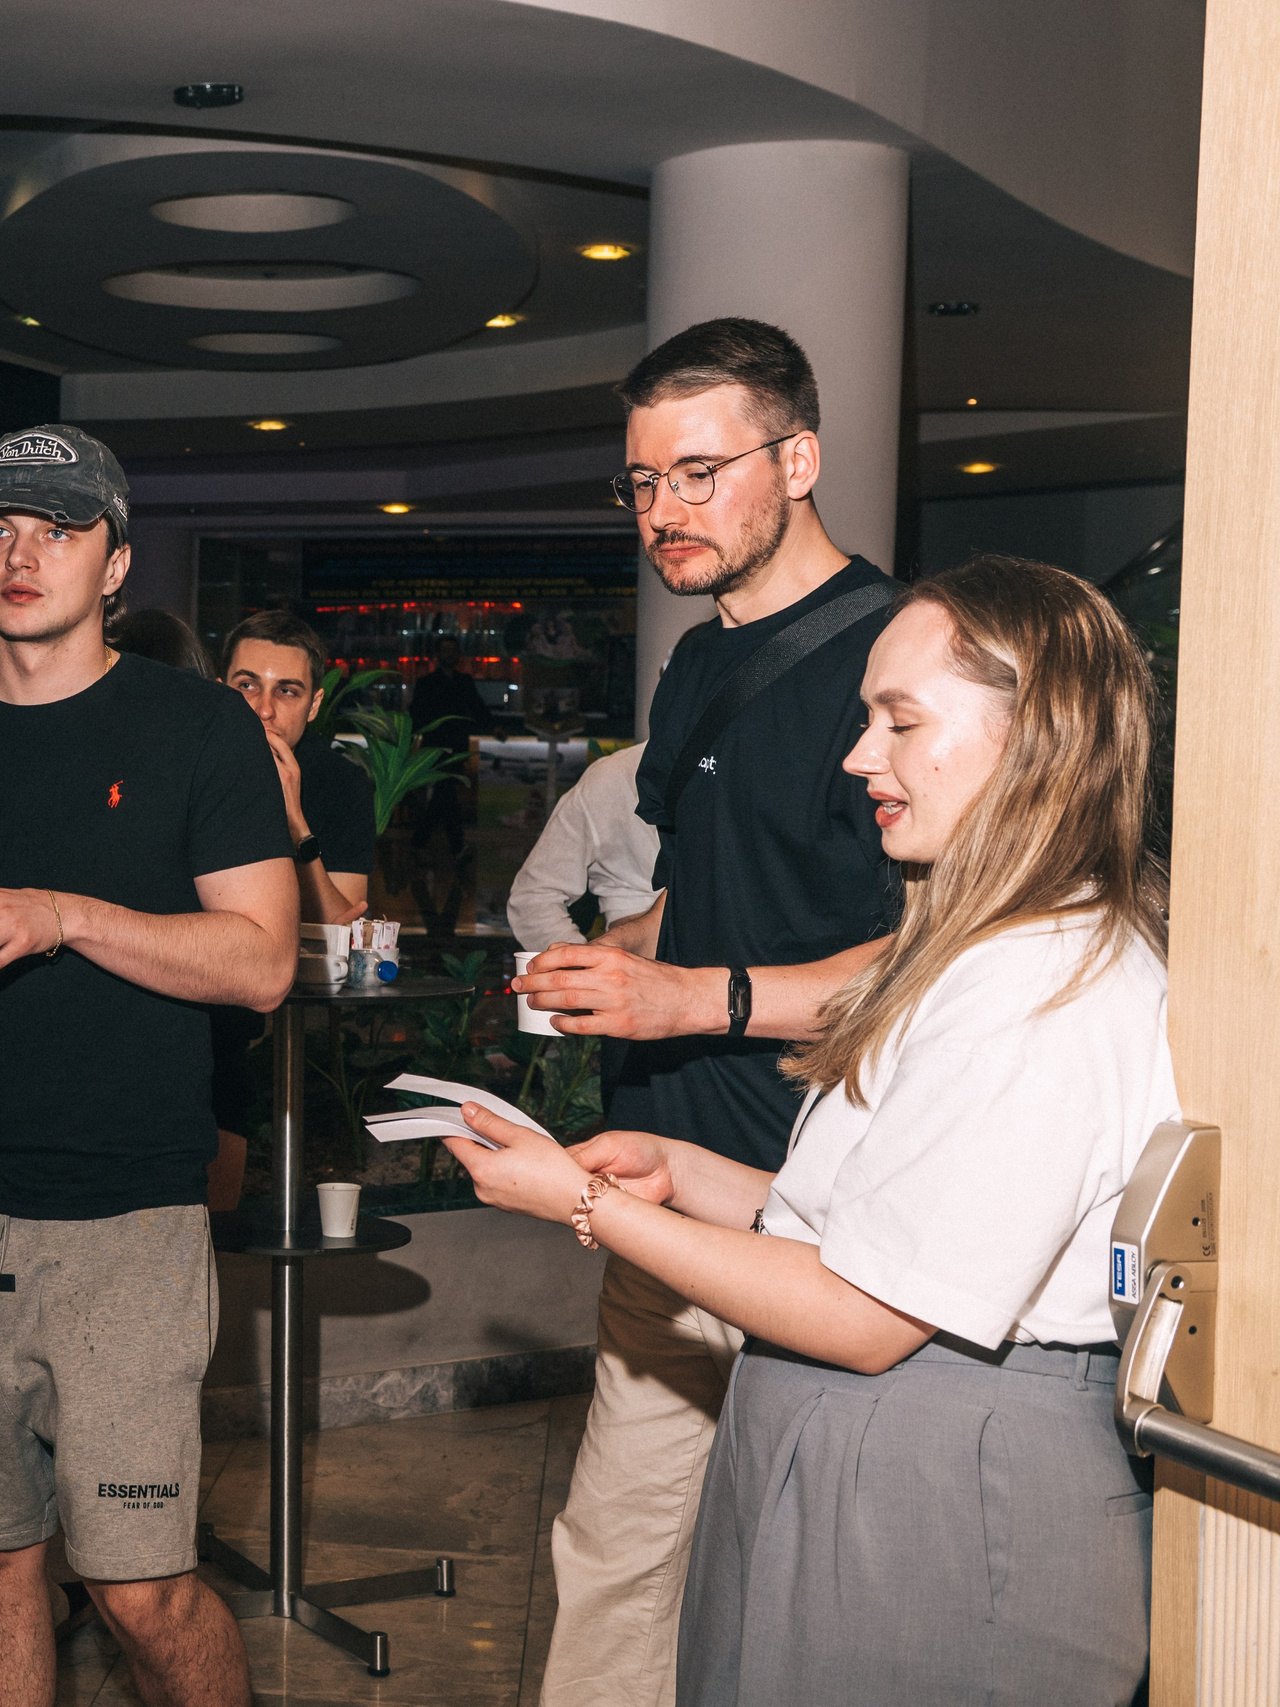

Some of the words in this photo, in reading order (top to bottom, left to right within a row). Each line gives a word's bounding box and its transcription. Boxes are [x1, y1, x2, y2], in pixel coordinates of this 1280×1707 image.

[0, 445, 19, 459] Von
[20, 440, 62, 459] Dutch
[98, 1482, 180, 1499] ESSENTIALS
